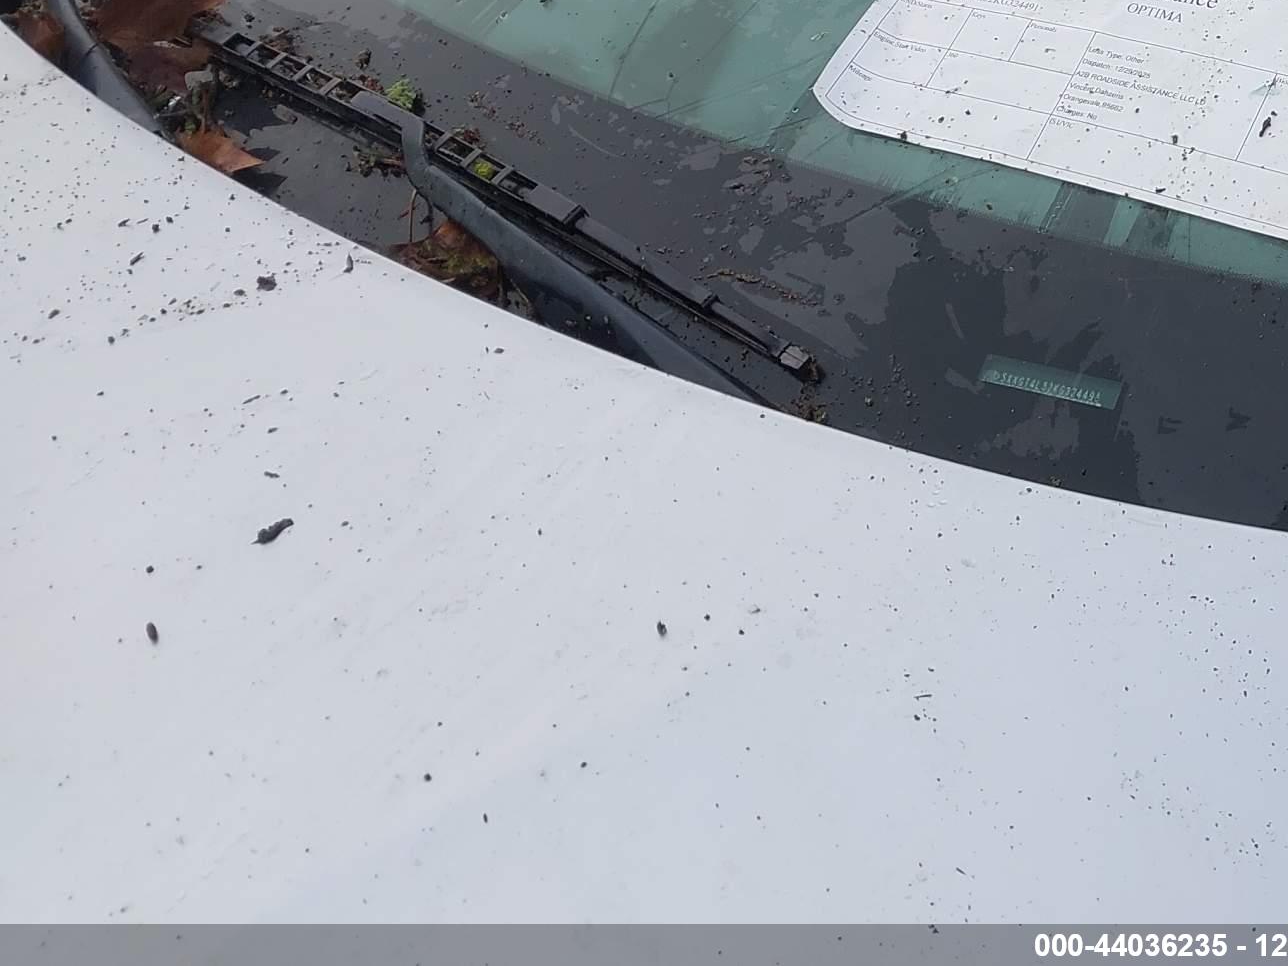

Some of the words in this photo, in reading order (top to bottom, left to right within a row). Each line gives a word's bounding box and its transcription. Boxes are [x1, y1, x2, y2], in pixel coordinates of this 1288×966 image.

[1127, 2, 1183, 24] OPTIMA
[1090, 73, 1130, 88] ROADSIDE
[1129, 82, 1179, 100] ASSISTANCE
